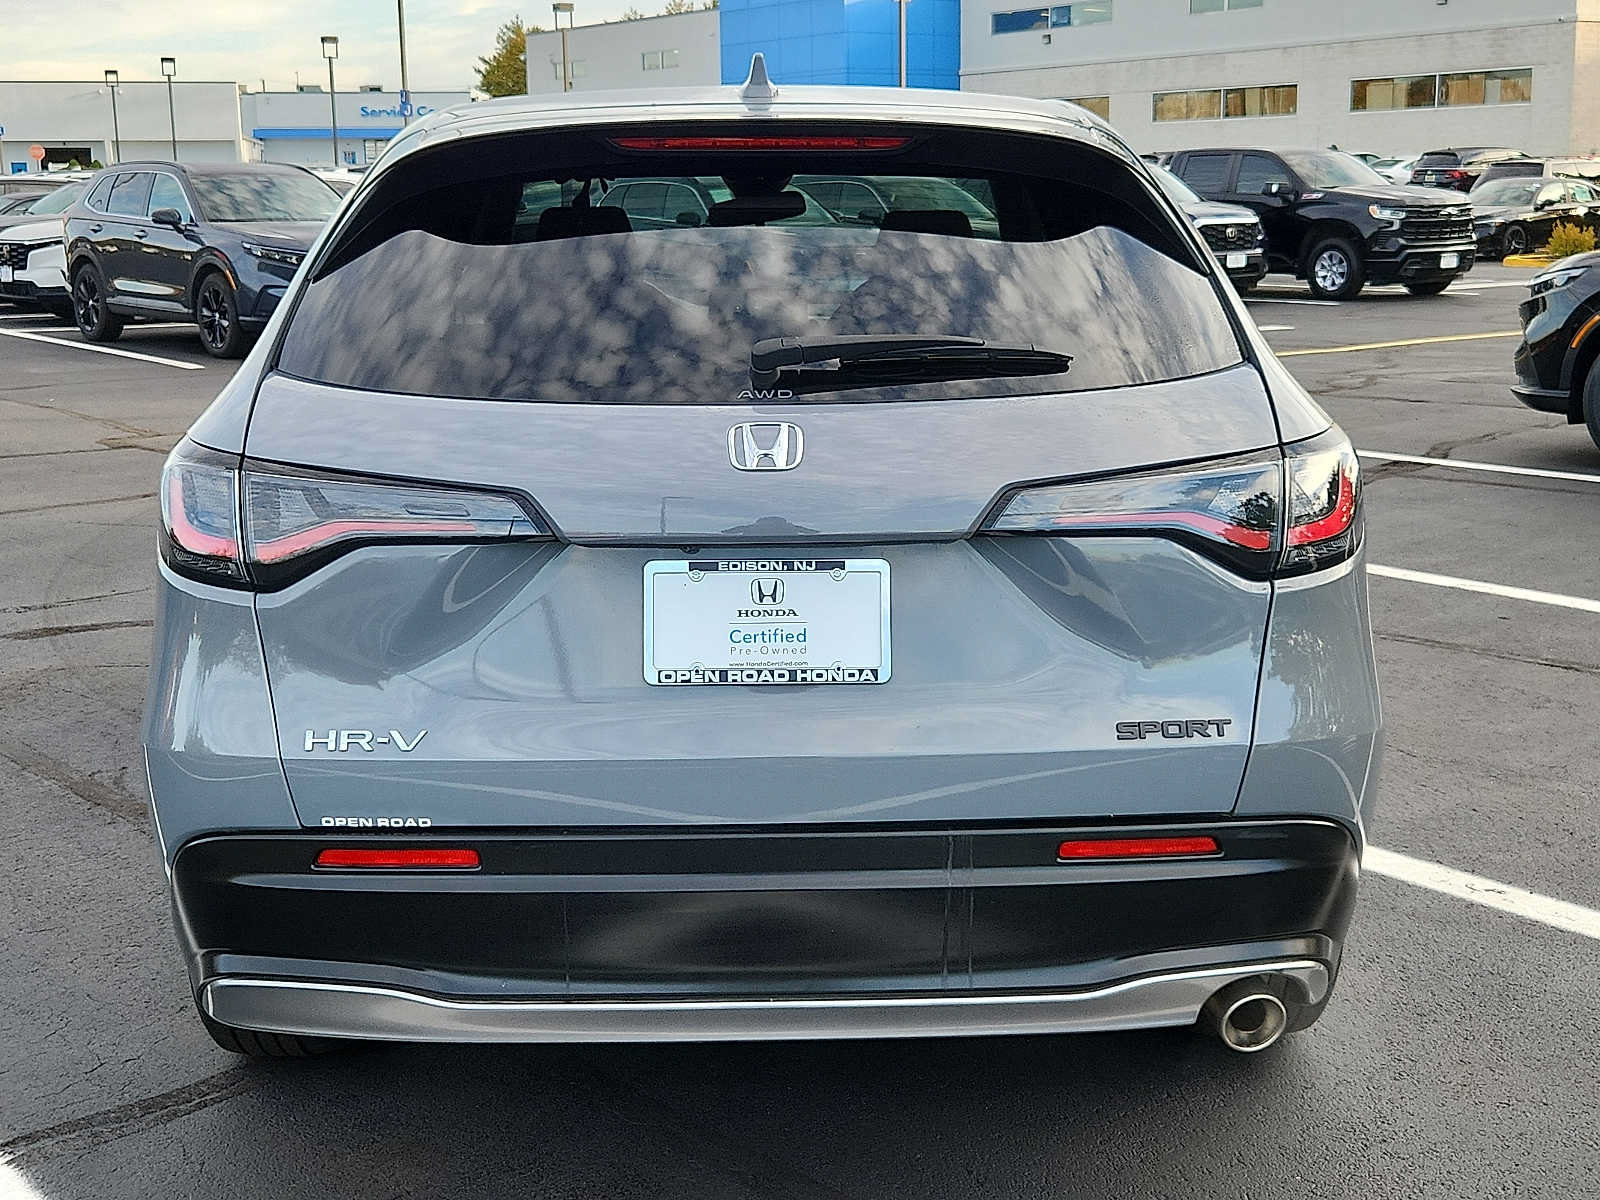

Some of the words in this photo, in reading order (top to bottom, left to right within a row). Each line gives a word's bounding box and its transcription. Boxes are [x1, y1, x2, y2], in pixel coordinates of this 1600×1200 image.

[361, 106, 400, 116] Servi
[737, 390, 793, 399] AWD
[718, 561, 788, 571] EDISON,
[793, 560, 816, 571] NJ
[737, 609, 799, 618] HONDA
[729, 627, 807, 644] Certified
[730, 645, 807, 655] Pre-Owned
[660, 670, 720, 683] OPEN
[727, 669, 790, 683] ROAD
[796, 669, 876, 682] HONDA
[1116, 719, 1232, 740] SPORT
[304, 729, 429, 752] HR-V
[321, 816, 373, 827] OPEN
[376, 817, 432, 827] ROAD
